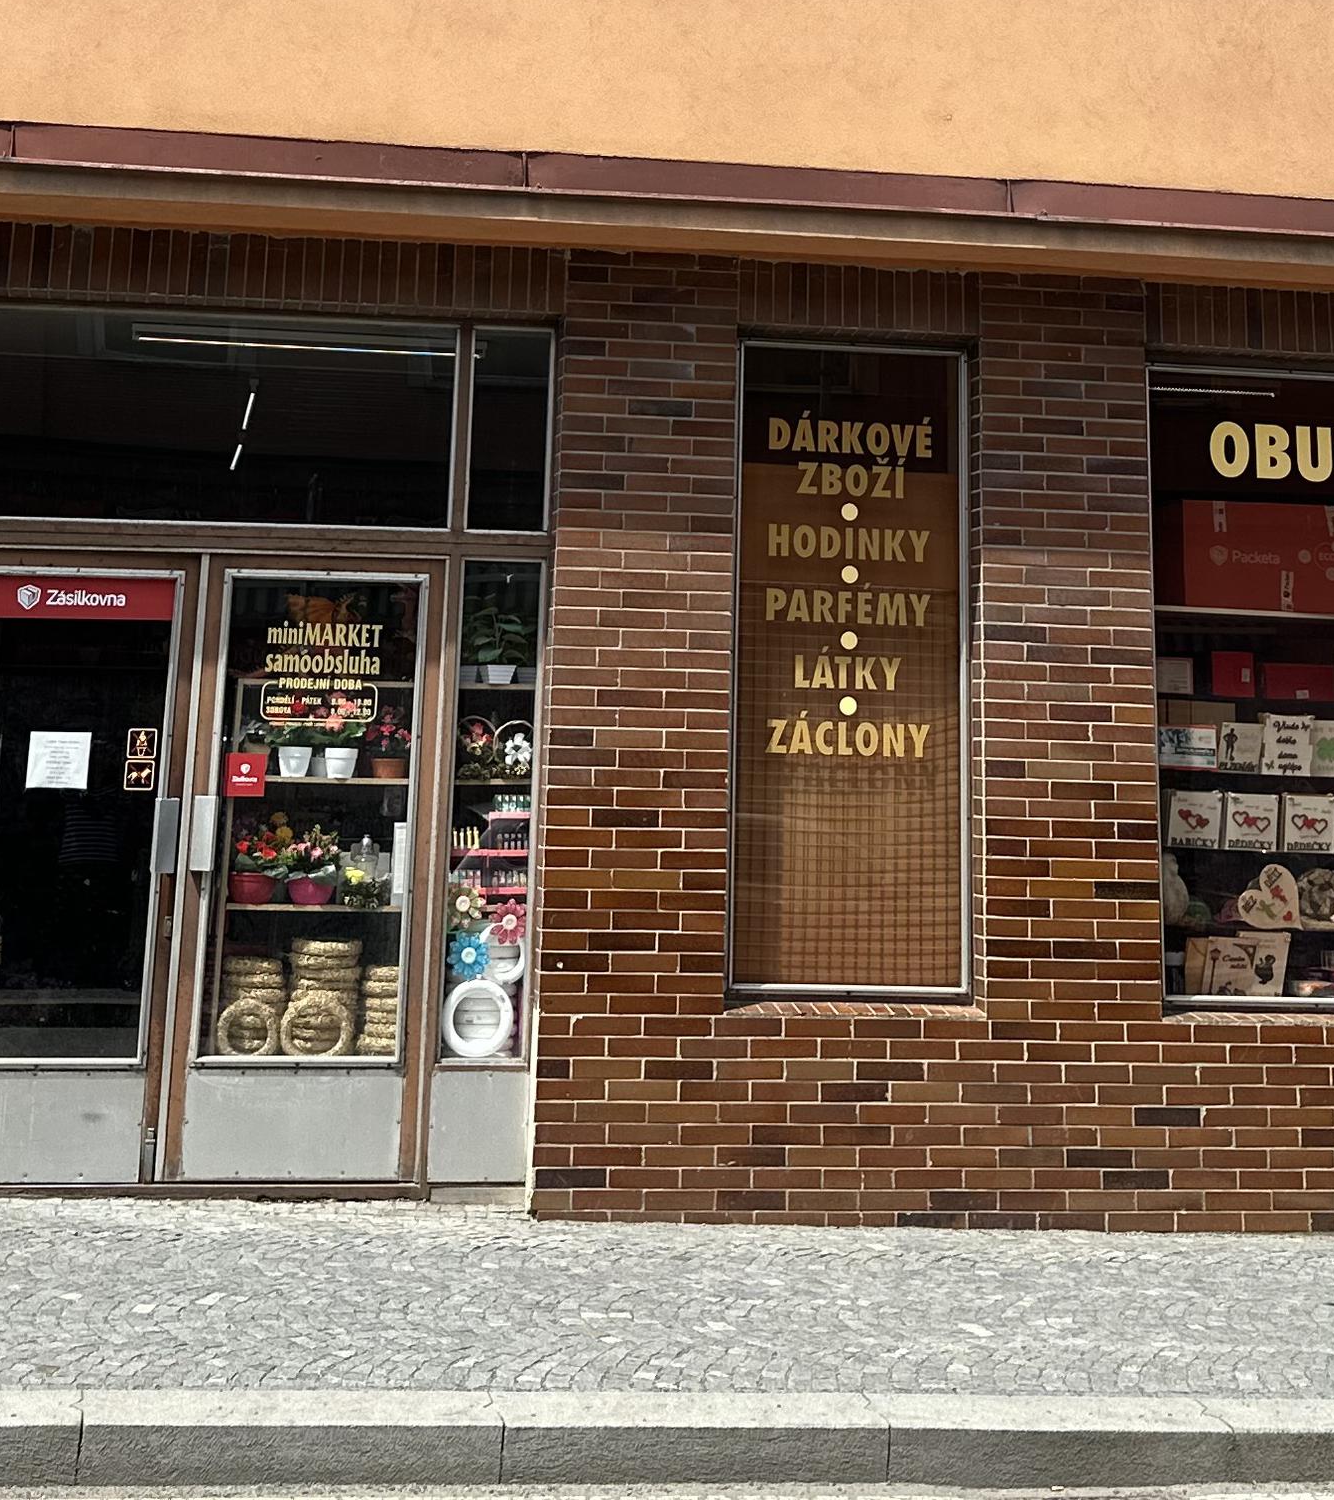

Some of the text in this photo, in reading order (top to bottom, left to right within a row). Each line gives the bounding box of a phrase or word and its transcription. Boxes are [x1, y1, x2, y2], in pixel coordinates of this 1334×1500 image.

[768, 410, 932, 458] DÁRKOVÉ
[796, 457, 905, 500] ZBOŽÍ
[768, 523, 931, 563] HODINKY
[1231, 549, 1281, 565] Packeta
[45, 589, 127, 607] Zásilkovna
[765, 582, 932, 627] PARFÉMY
[267, 620, 384, 648] miniMARKET
[265, 649, 381, 675] samoobsluha
[794, 646, 902, 691] LÁTKY
[278, 676, 363, 690] PRODEJNÍ DOBA
[301, 695, 322, 705] PÁTEK
[764, 710, 932, 758] ZÁCLONY
[1228, 838, 1274, 850] DĚDEČKY
[1286, 841, 1332, 852] DĚDEČKY
